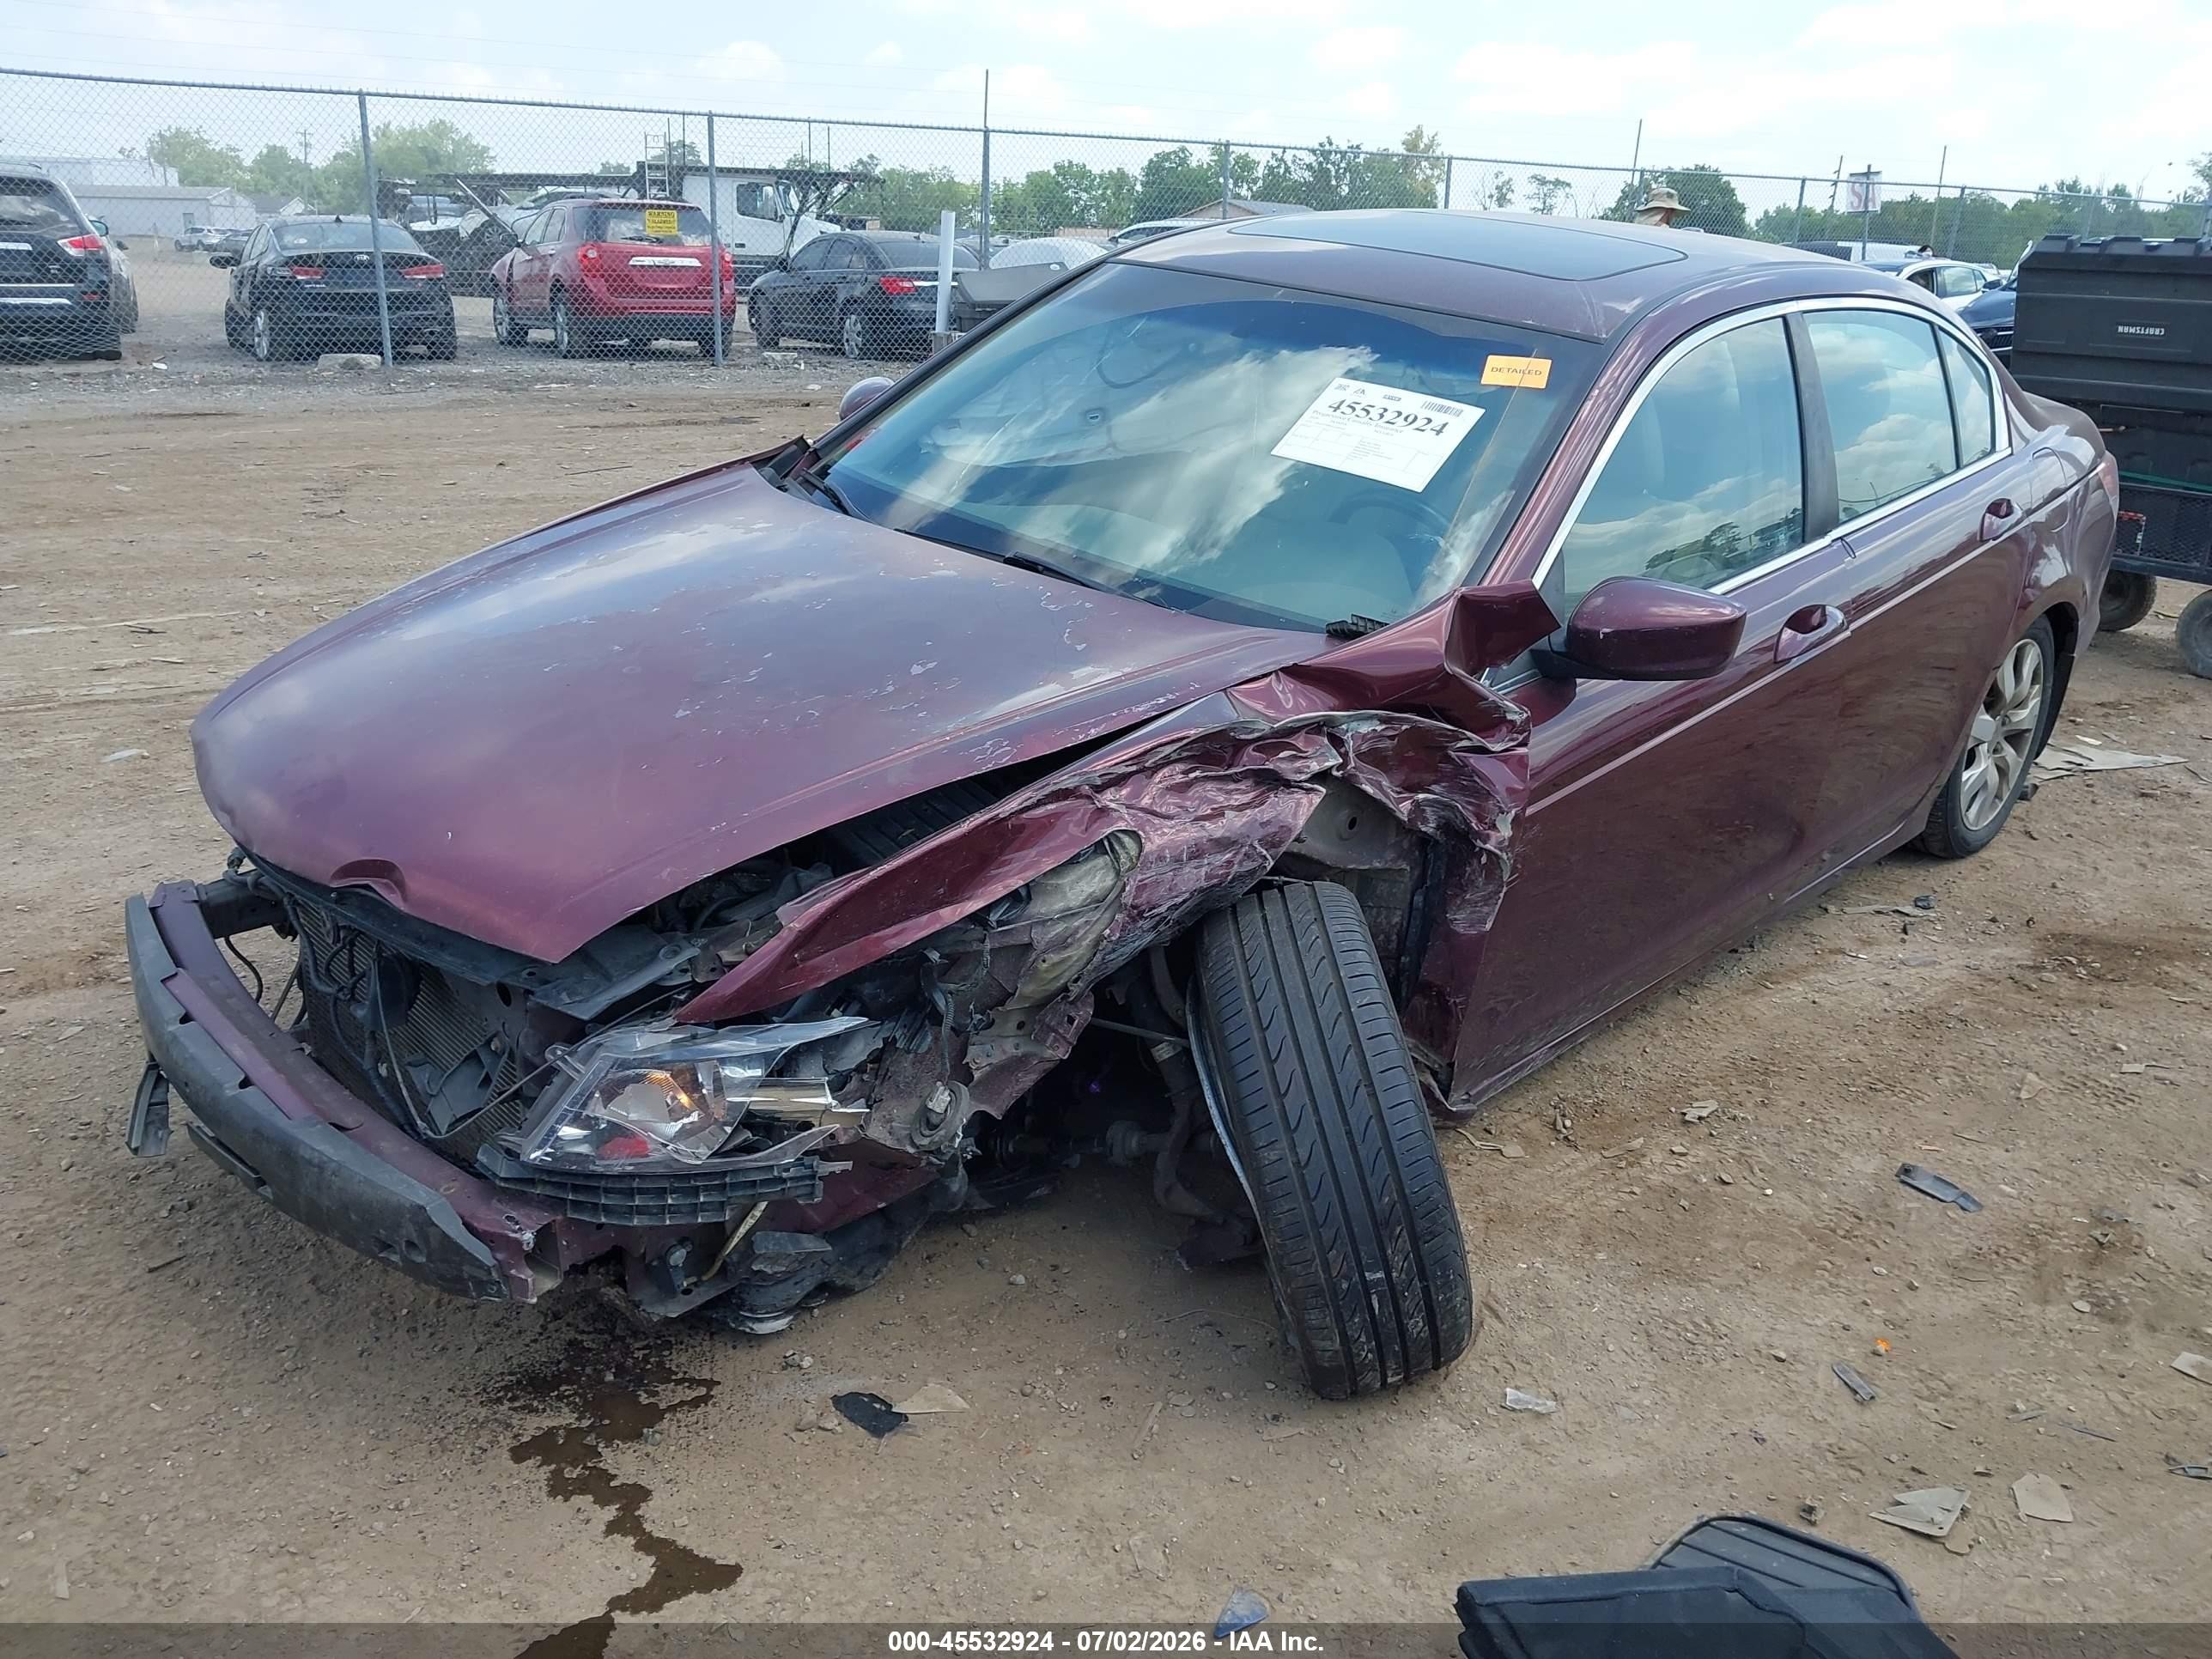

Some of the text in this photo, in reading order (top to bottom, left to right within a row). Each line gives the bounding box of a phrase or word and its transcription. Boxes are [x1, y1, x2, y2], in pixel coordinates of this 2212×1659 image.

[2118, 325, 2165, 336] CRAFTSMAN
[1490, 367, 1542, 376] DETAILED
[1328, 398, 1449, 436] 45532924
